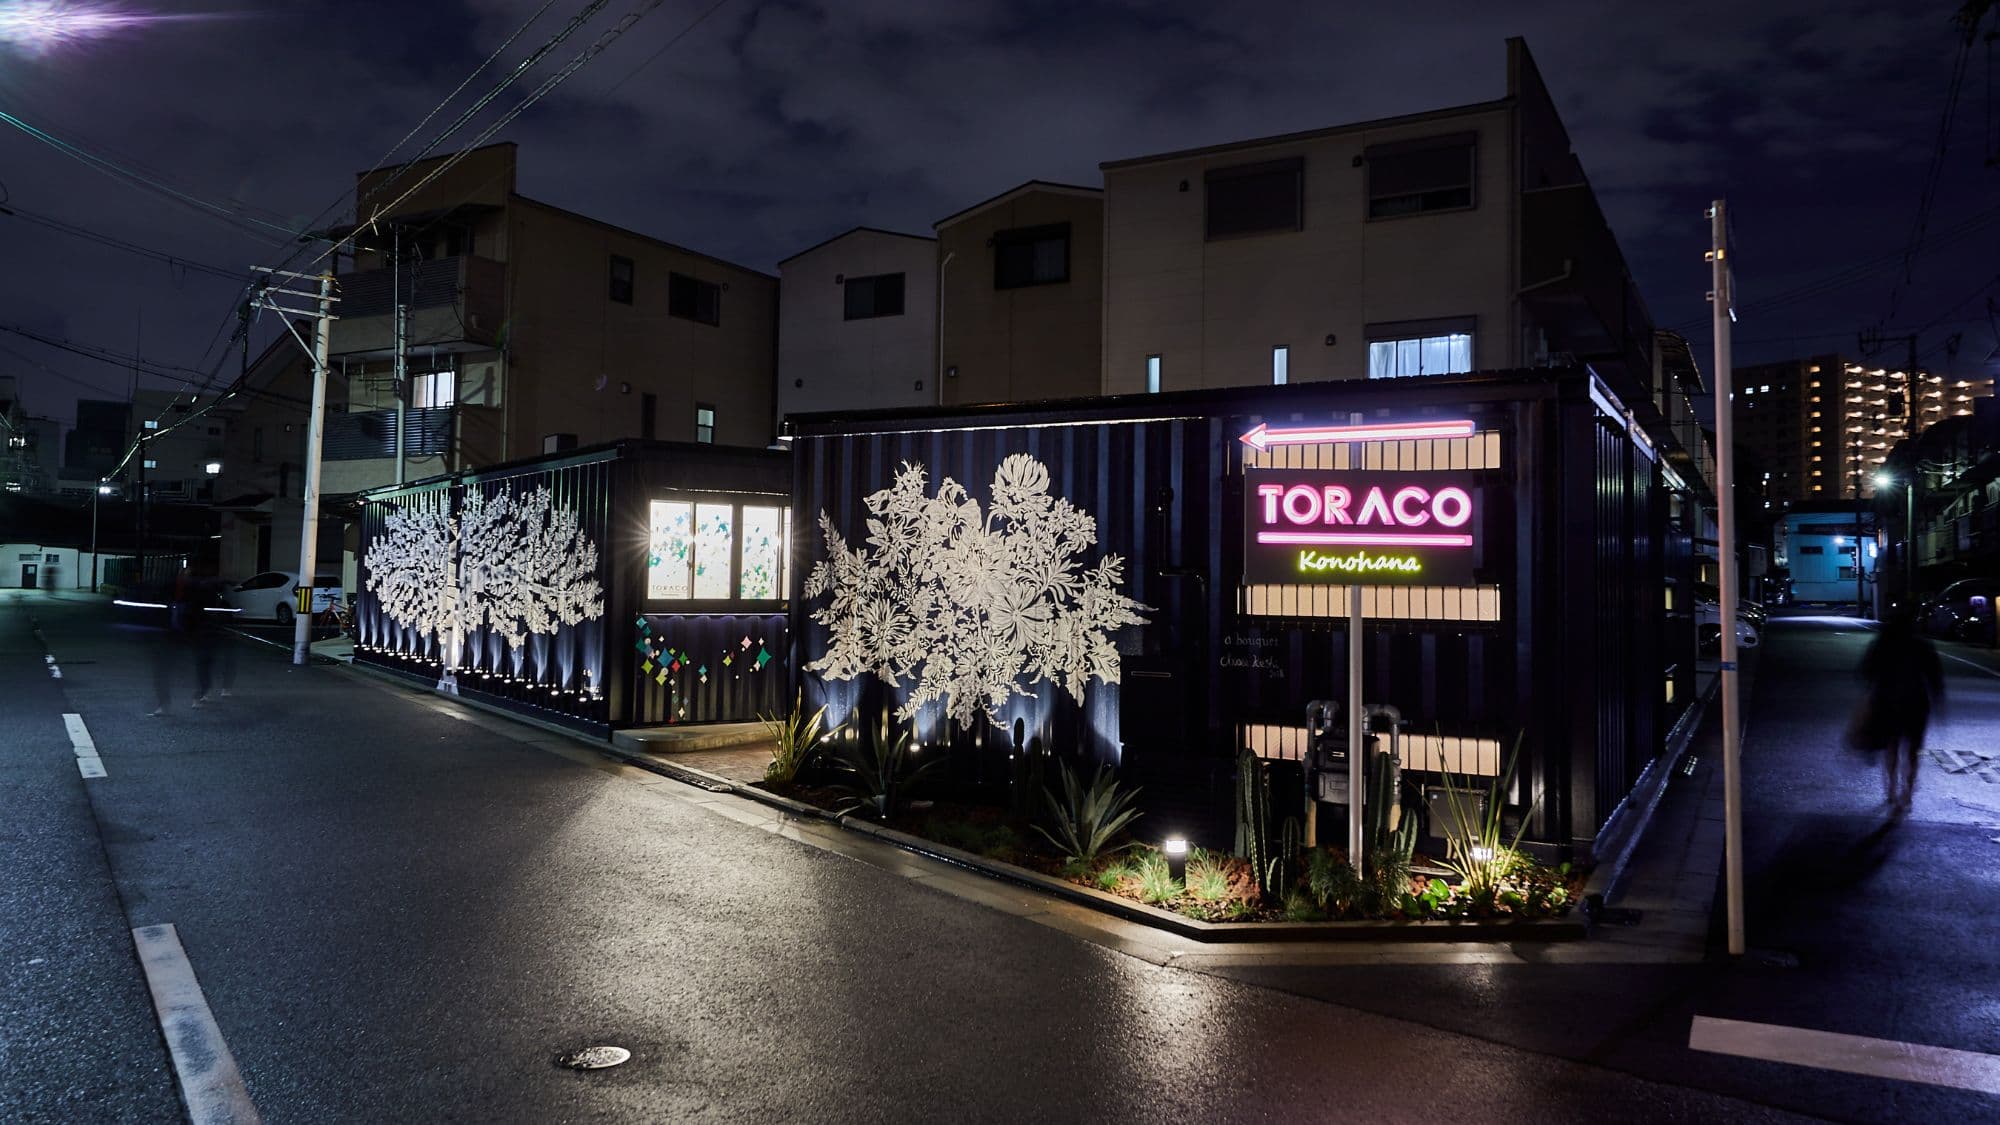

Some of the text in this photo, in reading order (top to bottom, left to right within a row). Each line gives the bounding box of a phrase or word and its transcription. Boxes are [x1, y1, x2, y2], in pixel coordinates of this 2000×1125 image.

[1257, 484, 1473, 527] TORACO
[1299, 550, 1422, 572] Konohana
[1236, 632, 1280, 648] bouquet
